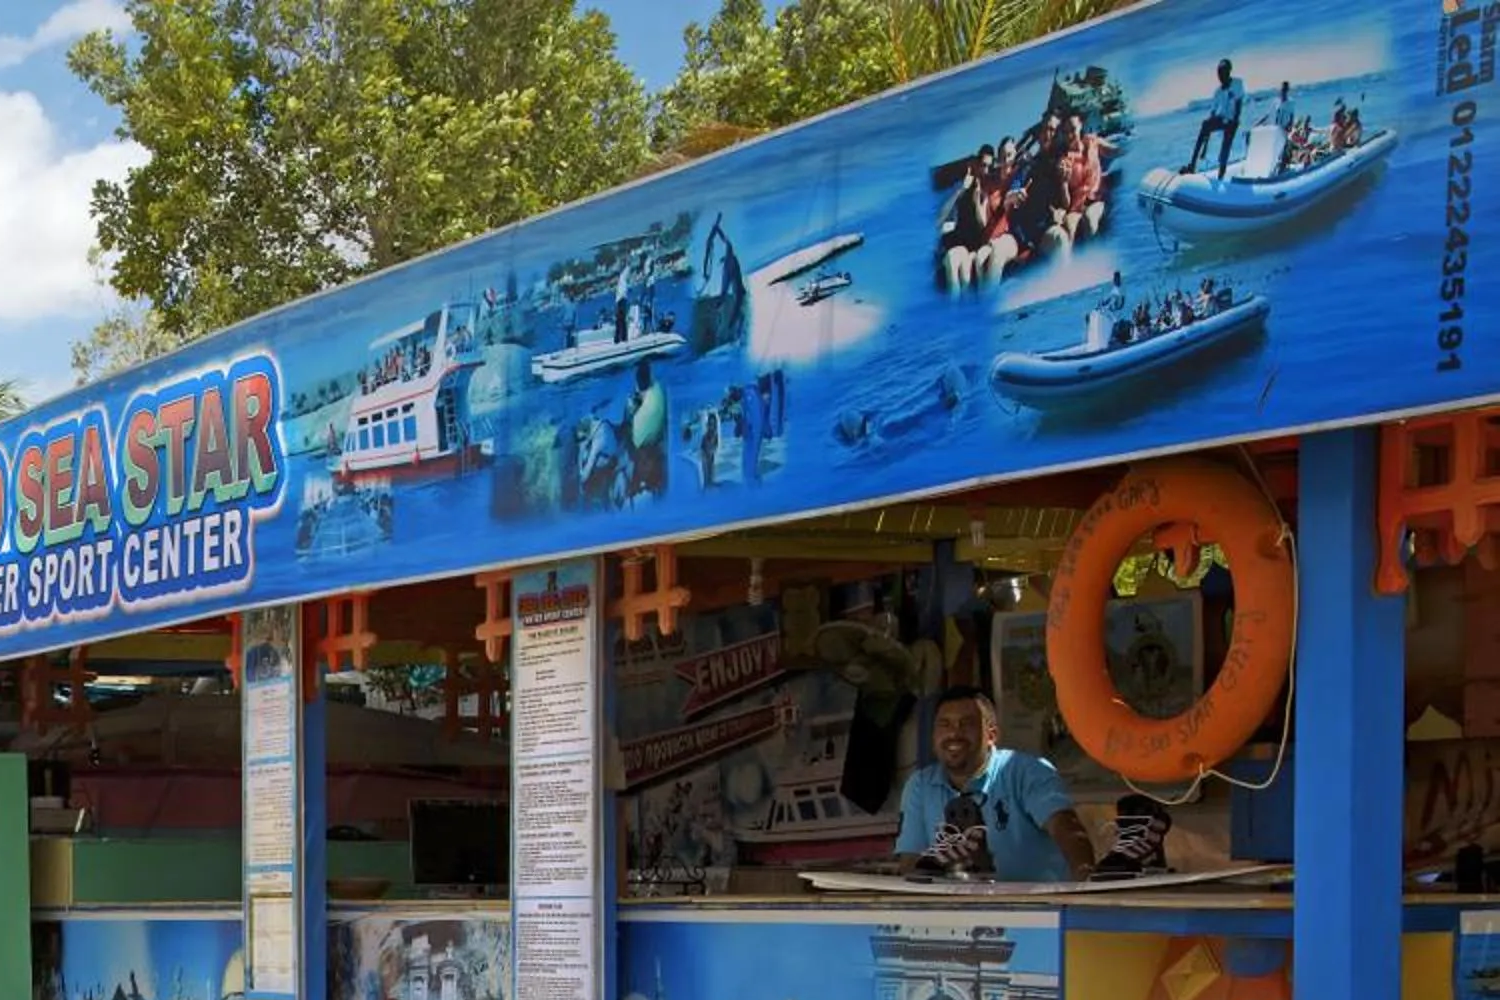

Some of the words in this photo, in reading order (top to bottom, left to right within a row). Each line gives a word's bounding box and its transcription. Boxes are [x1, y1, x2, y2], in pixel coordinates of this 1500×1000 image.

[1436, 101, 1477, 373] 01222435191
[15, 424, 112, 553] SEA
[122, 372, 278, 526] STAR
[27, 539, 114, 609] SPORT
[122, 508, 244, 588] CENTER
